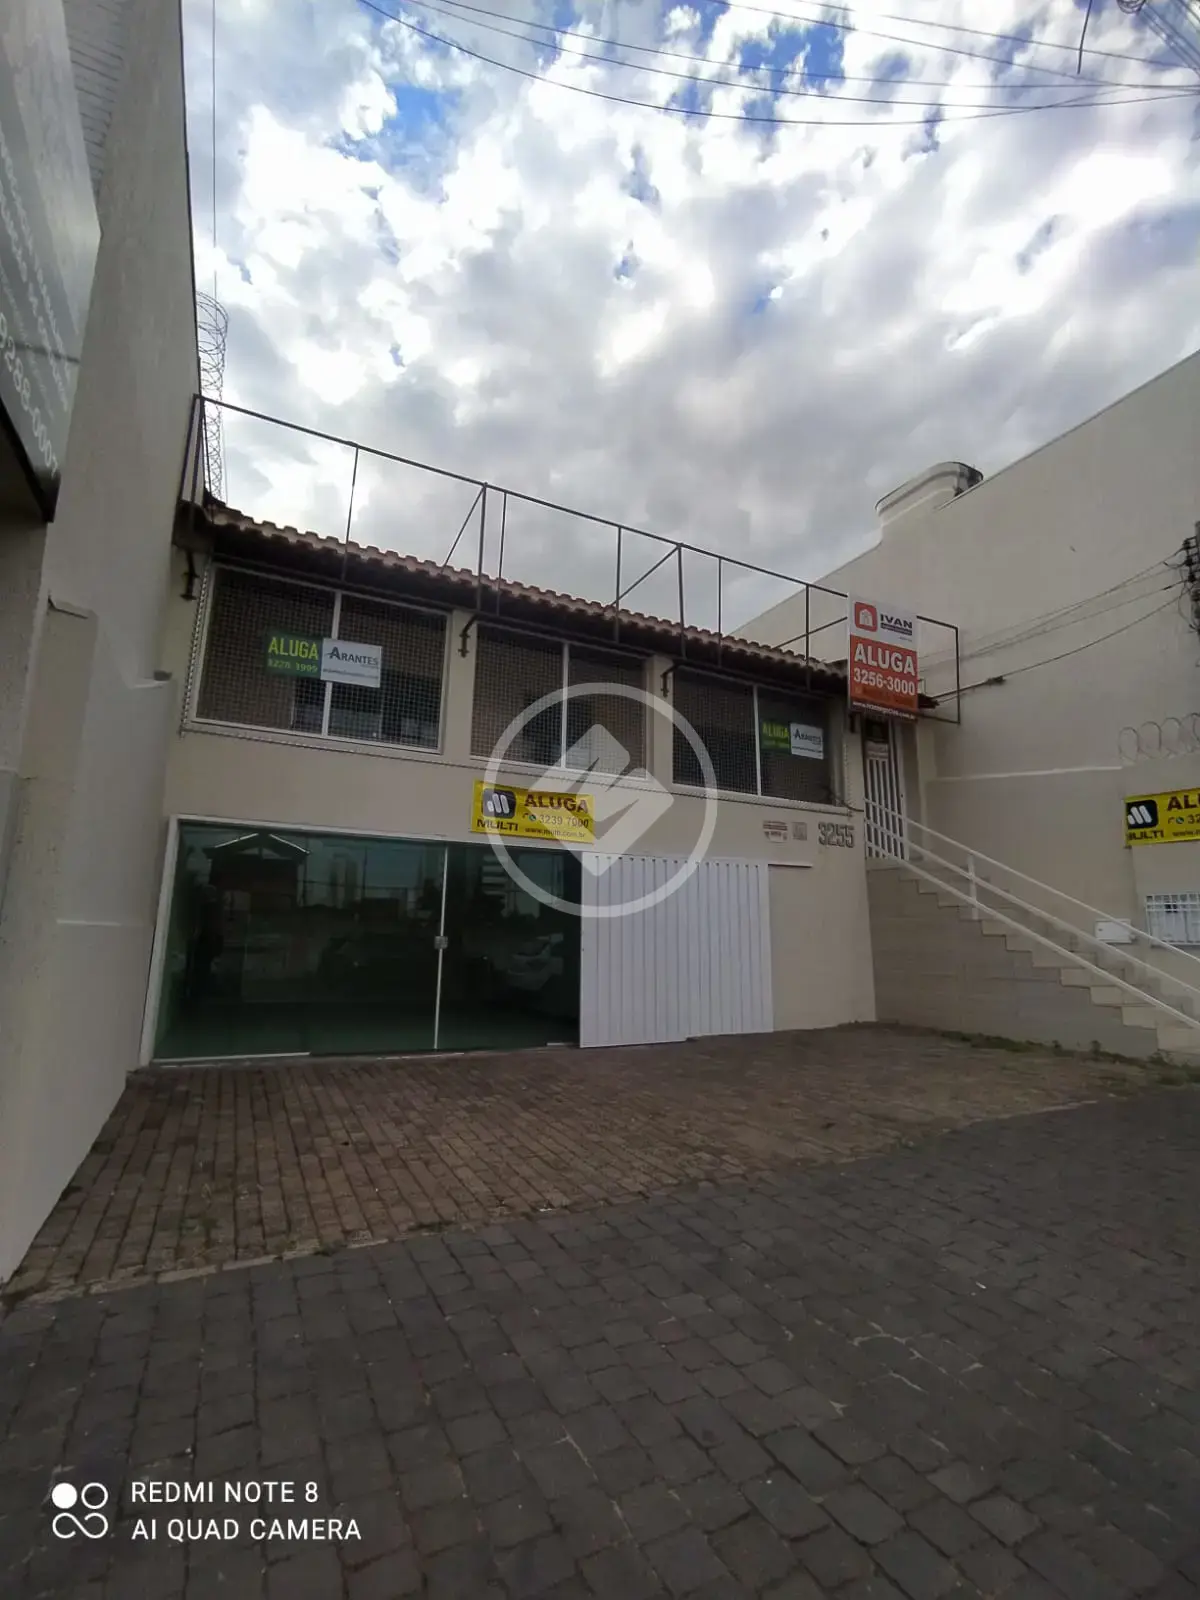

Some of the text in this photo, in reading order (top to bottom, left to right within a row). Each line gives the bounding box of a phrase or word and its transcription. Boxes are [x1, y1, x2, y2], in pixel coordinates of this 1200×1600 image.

[880, 614, 913, 629] IVAN
[267, 637, 319, 660] ALUGA
[854, 643, 916, 676] ALUGA
[853, 667, 916, 696] 3256-3000
[524, 794, 589, 814] ALUGA
[1167, 793, 1200, 811] AL
[477, 818, 519, 832] MULTI
[539, 814, 563, 825] 3239
[818, 821, 855, 848] 3255
